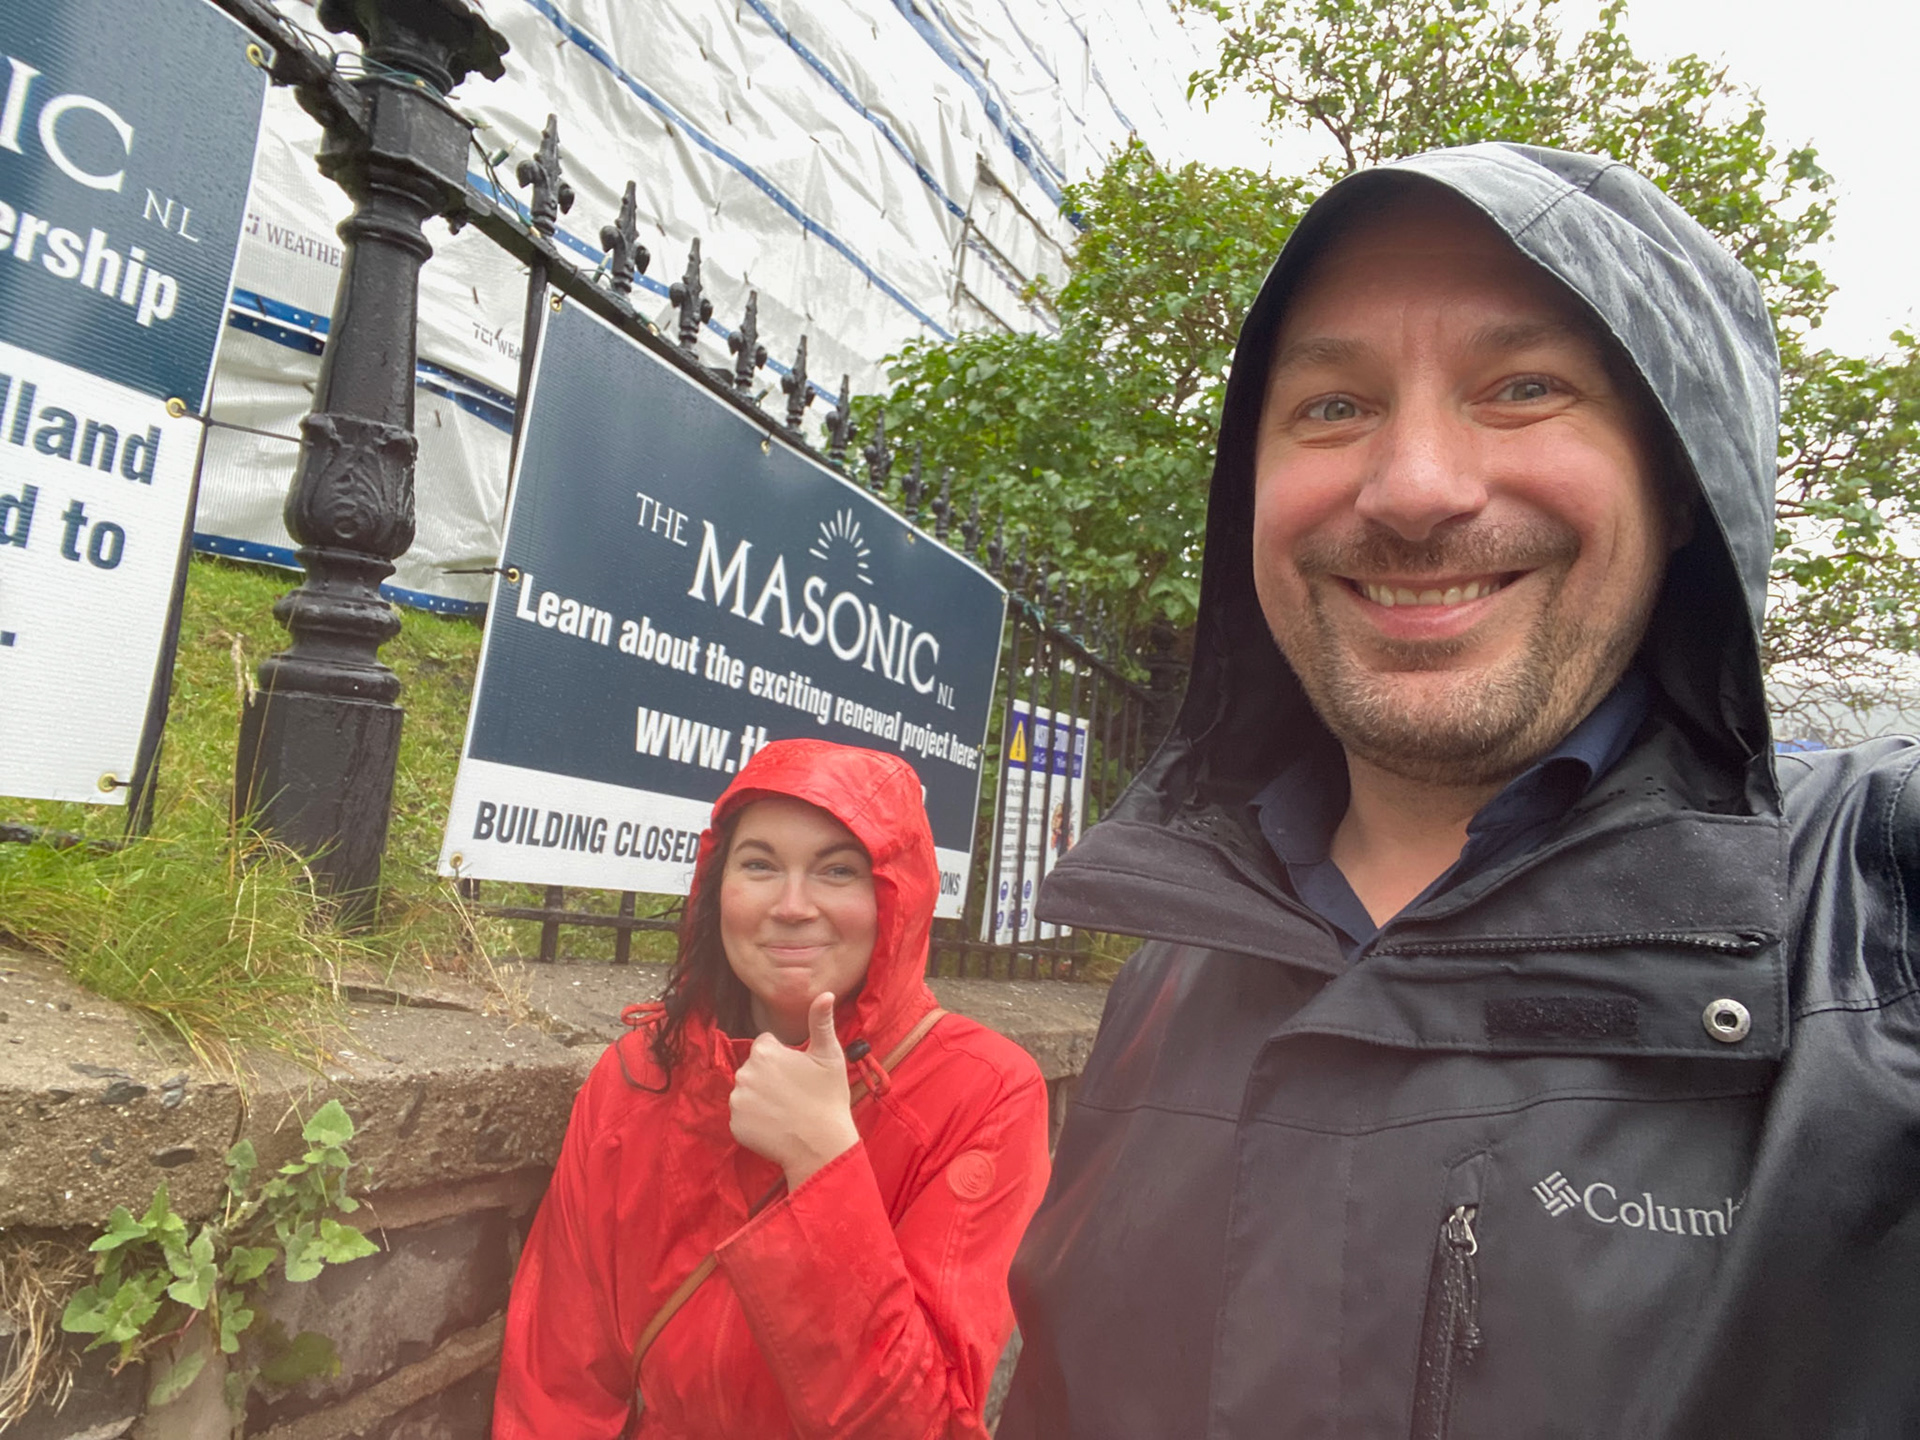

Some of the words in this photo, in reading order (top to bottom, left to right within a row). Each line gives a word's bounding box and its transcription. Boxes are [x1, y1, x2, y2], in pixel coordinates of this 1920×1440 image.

[142, 188, 199, 243] NL
[60, 499, 126, 570] to
[636, 492, 689, 547] THE
[687, 519, 940, 694] MASONIC
[936, 682, 956, 711] NL
[515, 573, 613, 647] Learn
[619, 616, 701, 675] about
[704, 642, 745, 689] the
[749, 666, 833, 726] exciting
[834, 696, 902, 742] renewal
[900, 722, 950, 759] project
[949, 733, 979, 770] here:
[472, 800, 608, 854] BUILDING
[613, 820, 701, 864] CLOSED
